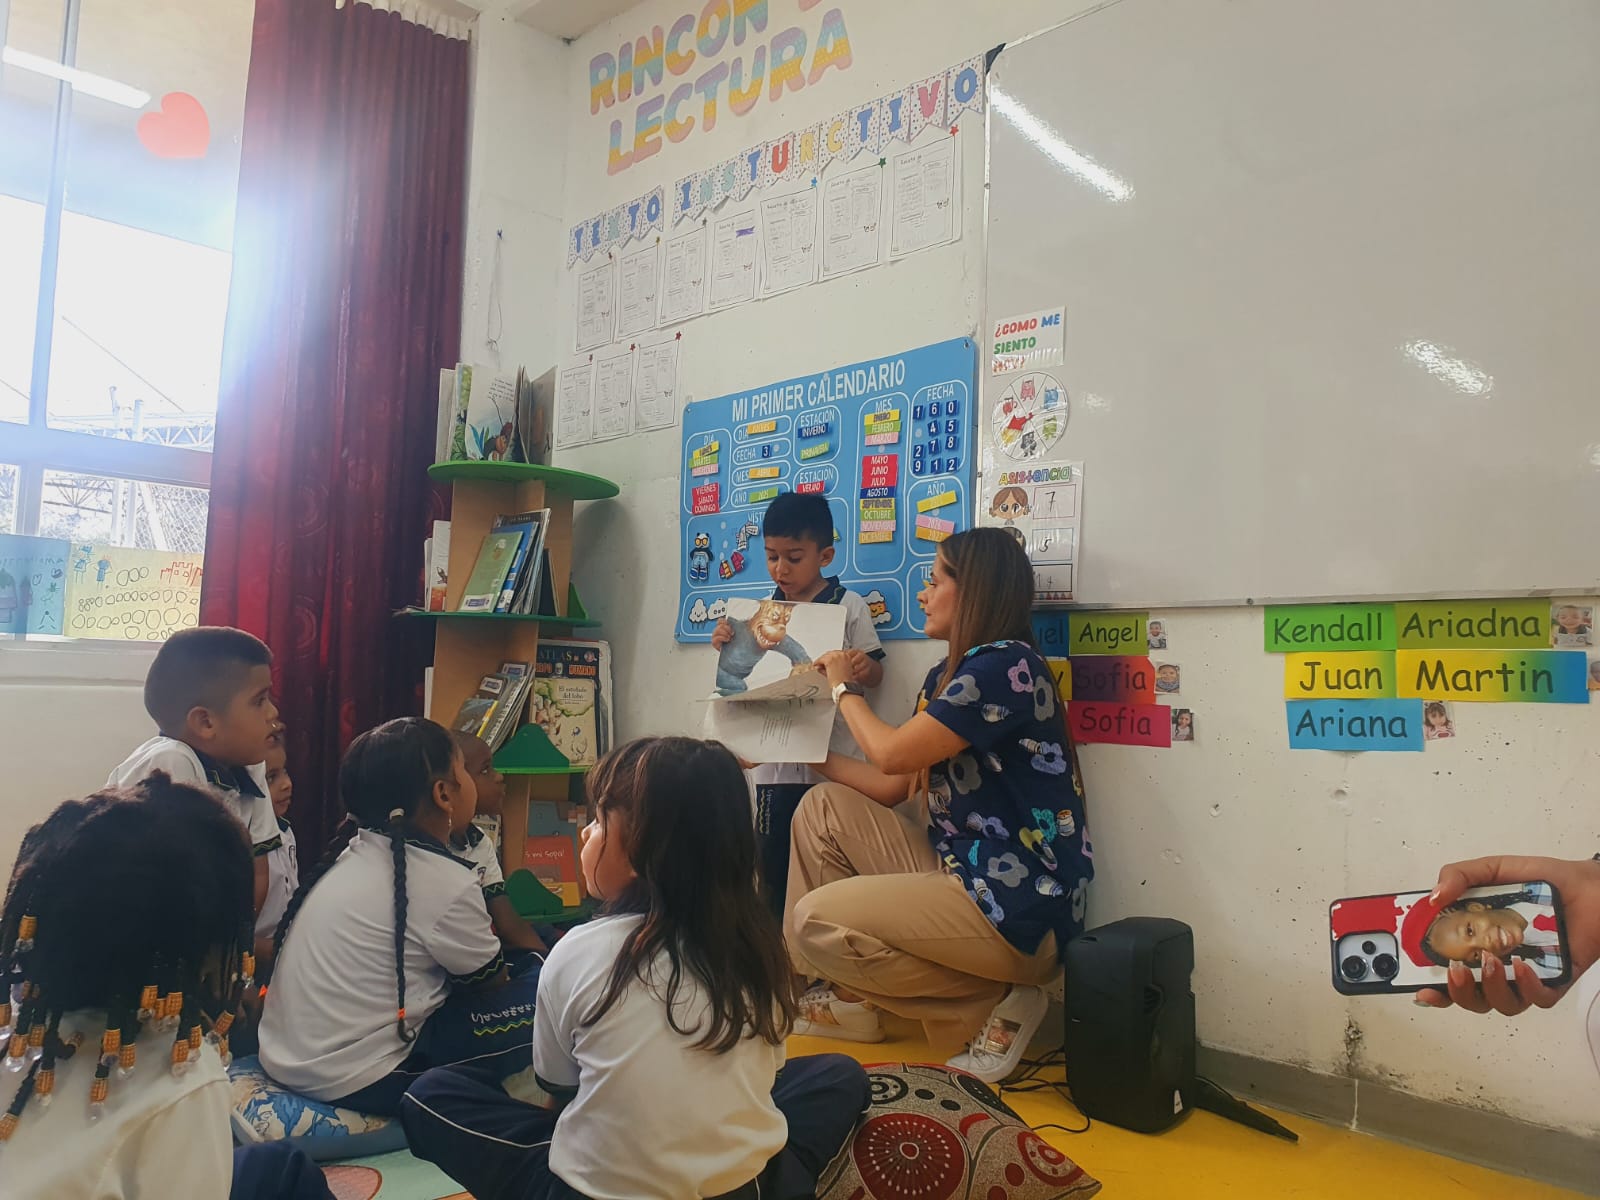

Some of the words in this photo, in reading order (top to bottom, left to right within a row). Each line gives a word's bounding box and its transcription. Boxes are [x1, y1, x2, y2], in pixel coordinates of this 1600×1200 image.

[589, 0, 768, 115] RINCON
[607, 8, 852, 176] LECTURA
[575, 194, 660, 254] TEXTO
[1041, 313, 1060, 327] ME
[994, 337, 1036, 354] SIENTO
[732, 397, 748, 422] MI
[751, 383, 804, 418] PRIMER
[807, 359, 906, 407] CALENDARIO
[927, 384, 954, 401] FECHA
[875, 398, 892, 414] MES
[931, 403, 938, 415] 6
[948, 402, 954, 413] 0
[930, 422, 936, 433] 4
[948, 420, 954, 432] 5
[736, 448, 756, 461] FECHA
[763, 446, 769, 457] 3
[915, 445, 922, 457] 2
[931, 440, 936, 452] 7
[948, 436, 954, 448] 8
[871, 455, 888, 465] MAYO
[915, 461, 921, 472] 9
[948, 459, 955, 471] 2
[736, 471, 750, 483] MES
[871, 466, 889, 476] JUNIO
[802, 483, 821, 493] VERANO
[871, 477, 886, 487] JULIO
[927, 481, 946, 497] AÑO
[867, 487, 888, 497] AGOSTO
[695, 504, 716, 513] DOMINGO
[1045, 490, 1057, 512] 7
[864, 510, 891, 520] OCTUBRE
[1039, 619, 1063, 644] iel
[1274, 613, 1382, 644] Kendall
[1402, 608, 1541, 639] Ariadna
[1078, 619, 1139, 649] Angel
[1075, 663, 1148, 691] Sofia
[1300, 661, 1383, 691] Juan
[1416, 660, 1554, 694] Martin
[1079, 707, 1152, 736] Sofia
[1295, 708, 1408, 738] Ariana
